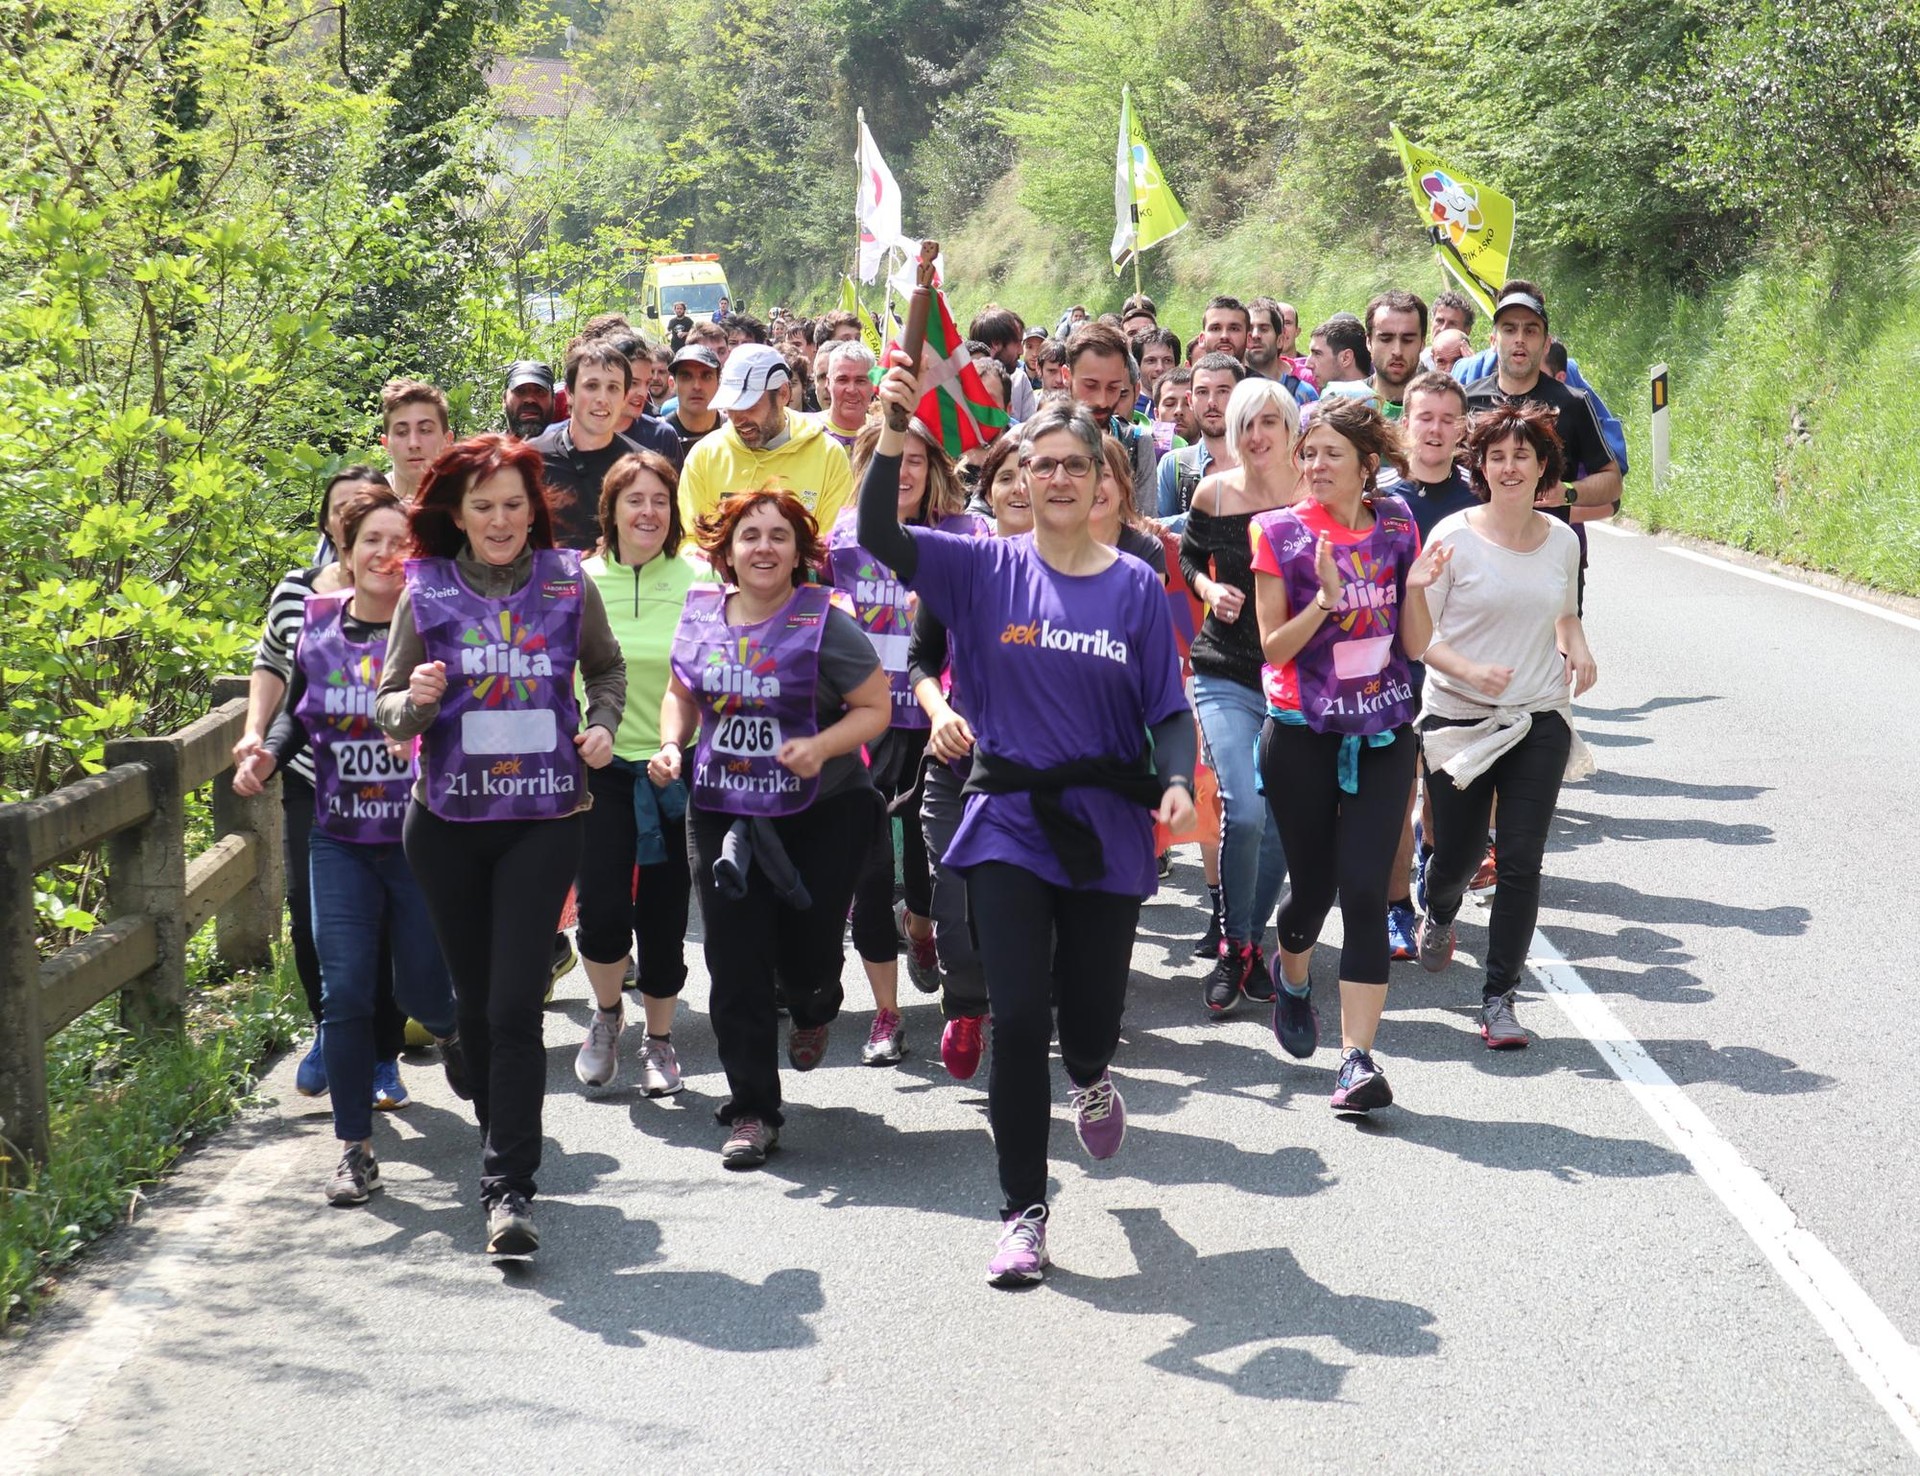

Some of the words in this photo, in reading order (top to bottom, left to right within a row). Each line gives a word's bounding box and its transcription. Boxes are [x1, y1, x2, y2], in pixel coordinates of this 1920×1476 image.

[1478, 228, 1495, 254] ASKO
[436, 585, 460, 599] eitb
[856, 579, 913, 610] Klik
[1000, 619, 1042, 647] aek
[1040, 619, 1128, 665] korrika
[460, 642, 553, 678] Klika
[702, 664, 781, 698] Klika
[1363, 680, 1381, 695] ae
[324, 684, 377, 719] Kli
[1320, 696, 1354, 716] 21.
[717, 716, 774, 752] 2036
[491, 756, 524, 775] aek
[695, 763, 716, 788] 21.
[718, 764, 801, 794] korrika
[444, 772, 477, 796] 21.
[482, 768, 575, 796] korrika
[352, 792, 411, 820] korri
